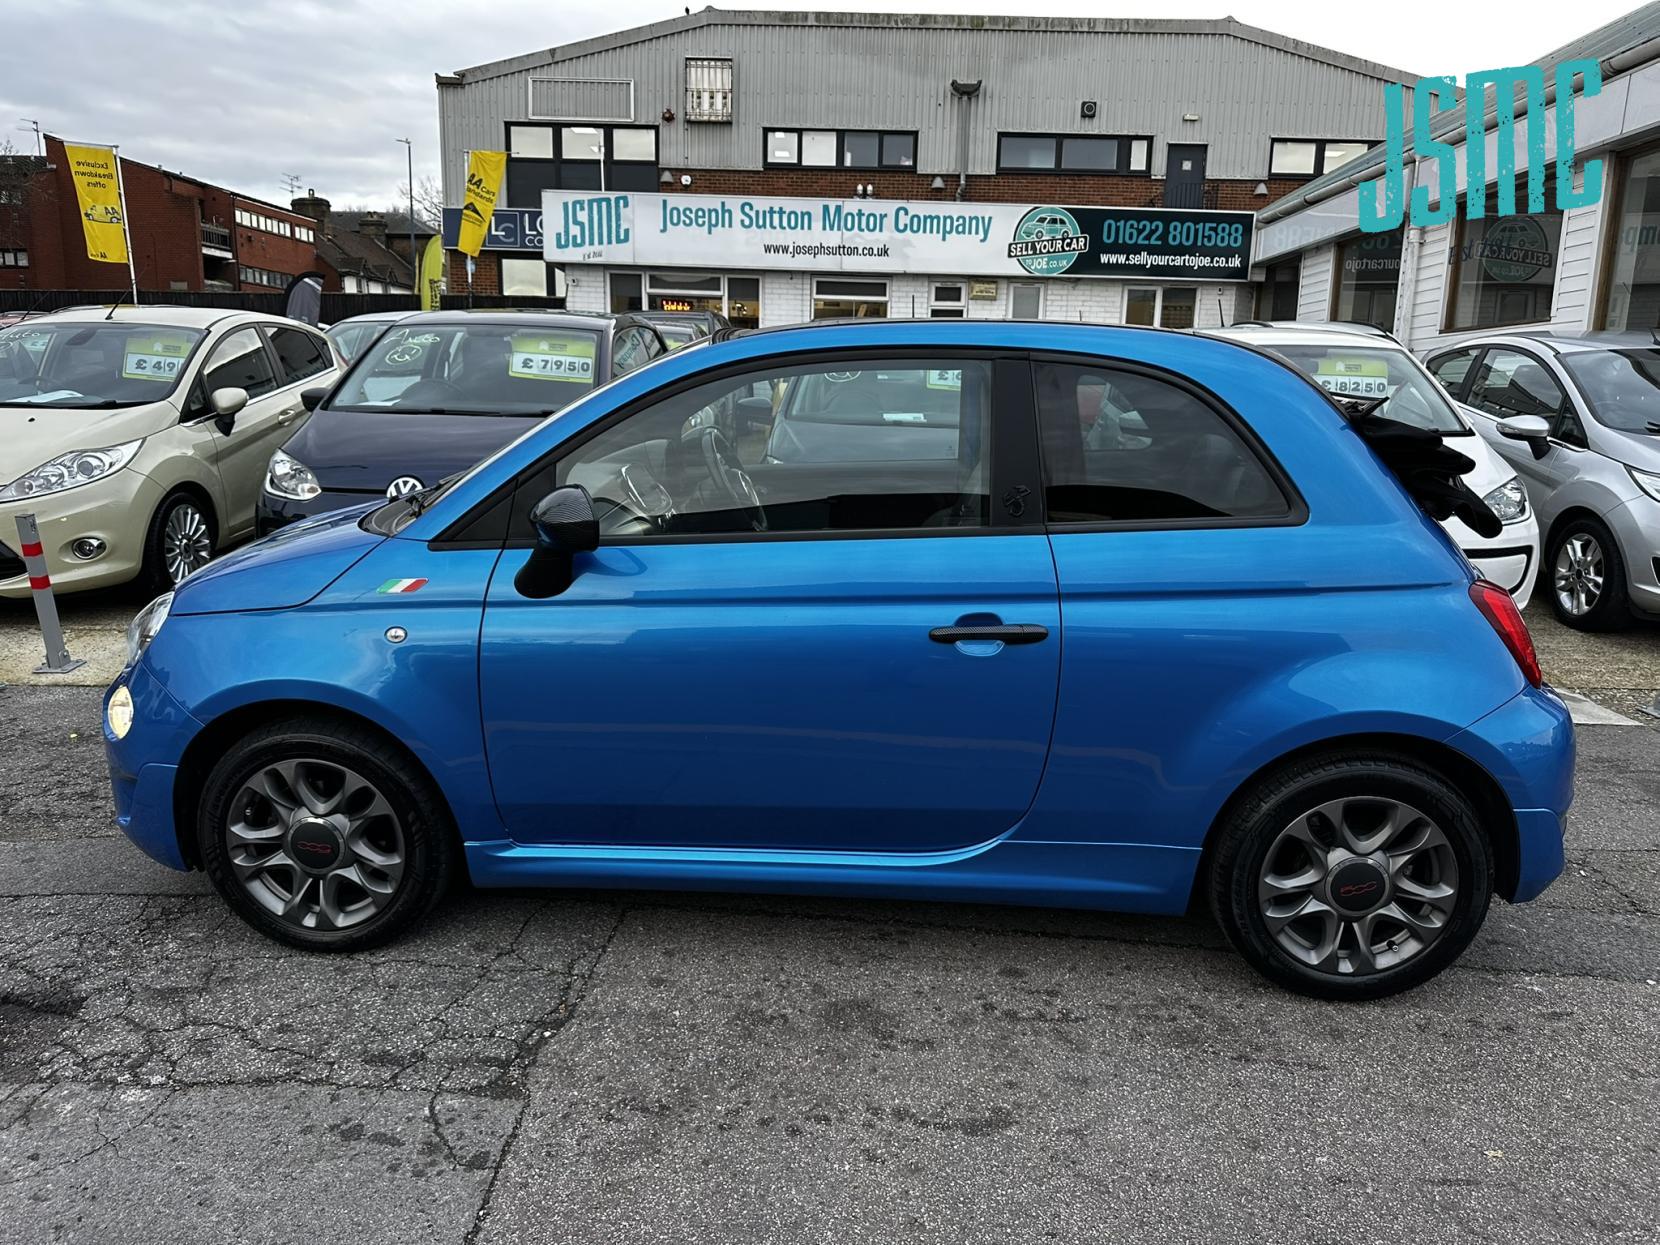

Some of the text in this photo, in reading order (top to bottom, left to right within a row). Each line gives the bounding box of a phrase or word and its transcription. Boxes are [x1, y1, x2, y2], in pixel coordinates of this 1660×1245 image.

[467, 173, 483, 190] AA
[555, 195, 631, 250] JSMC
[659, 199, 992, 242] Joseph Sutton Motor Company
[1102, 219, 1163, 245] 01622
[1168, 222, 1243, 247] 801588
[763, 241, 890, 259] www.josephsutton.co.uk
[1010, 237, 1086, 257] SELL YOUR CAR
[1100, 252, 1242, 270] www.sellyourcartojoe.co.uk
[135, 358, 180, 372] £49
[521, 357, 590, 372] £7950
